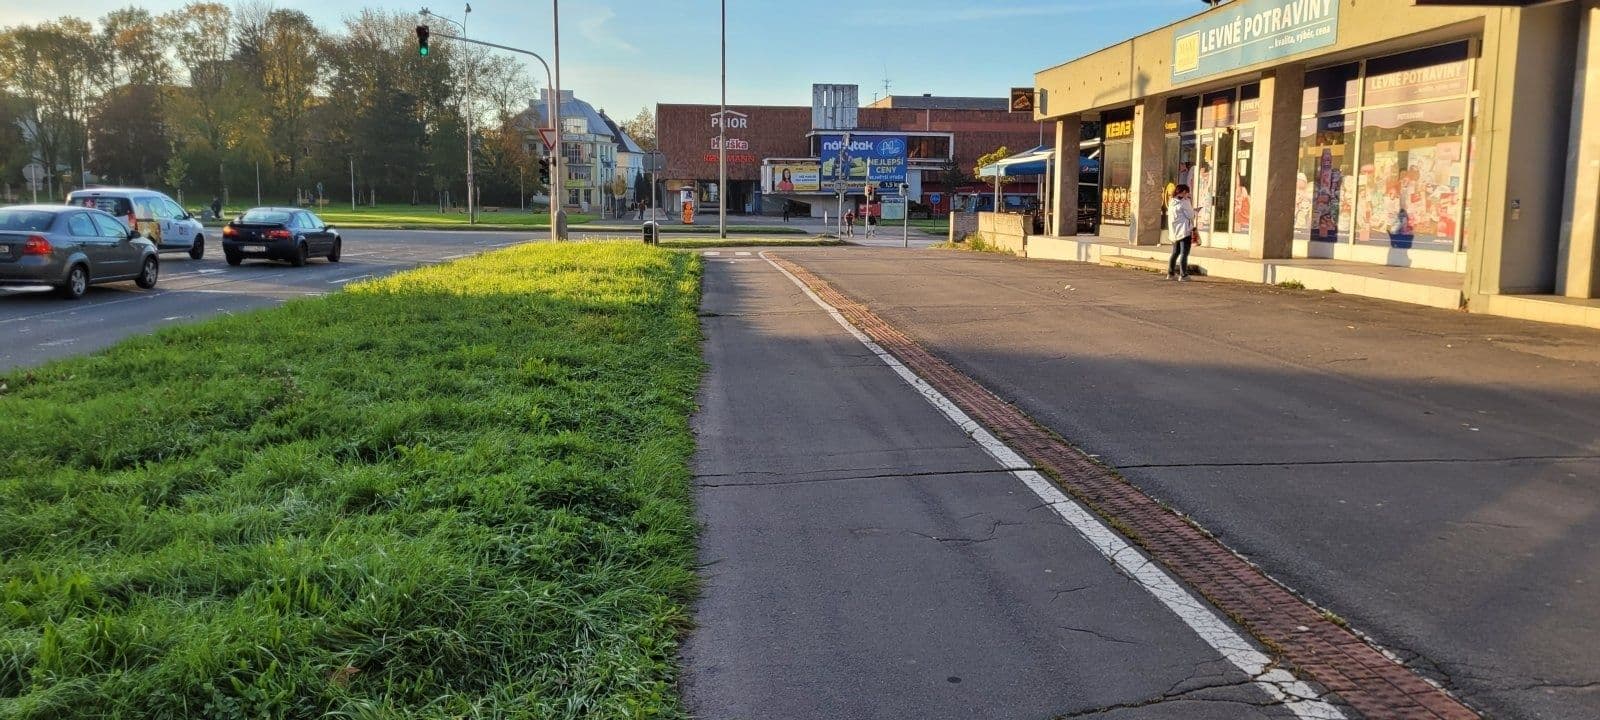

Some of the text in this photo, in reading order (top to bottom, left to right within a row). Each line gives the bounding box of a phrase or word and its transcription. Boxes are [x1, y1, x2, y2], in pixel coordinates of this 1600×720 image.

[1201, 16, 1243, 53] LEVNÉ
[1244, 0, 1332, 40] POTRAVINY
[1403, 64, 1463, 85] POTRAVINY
